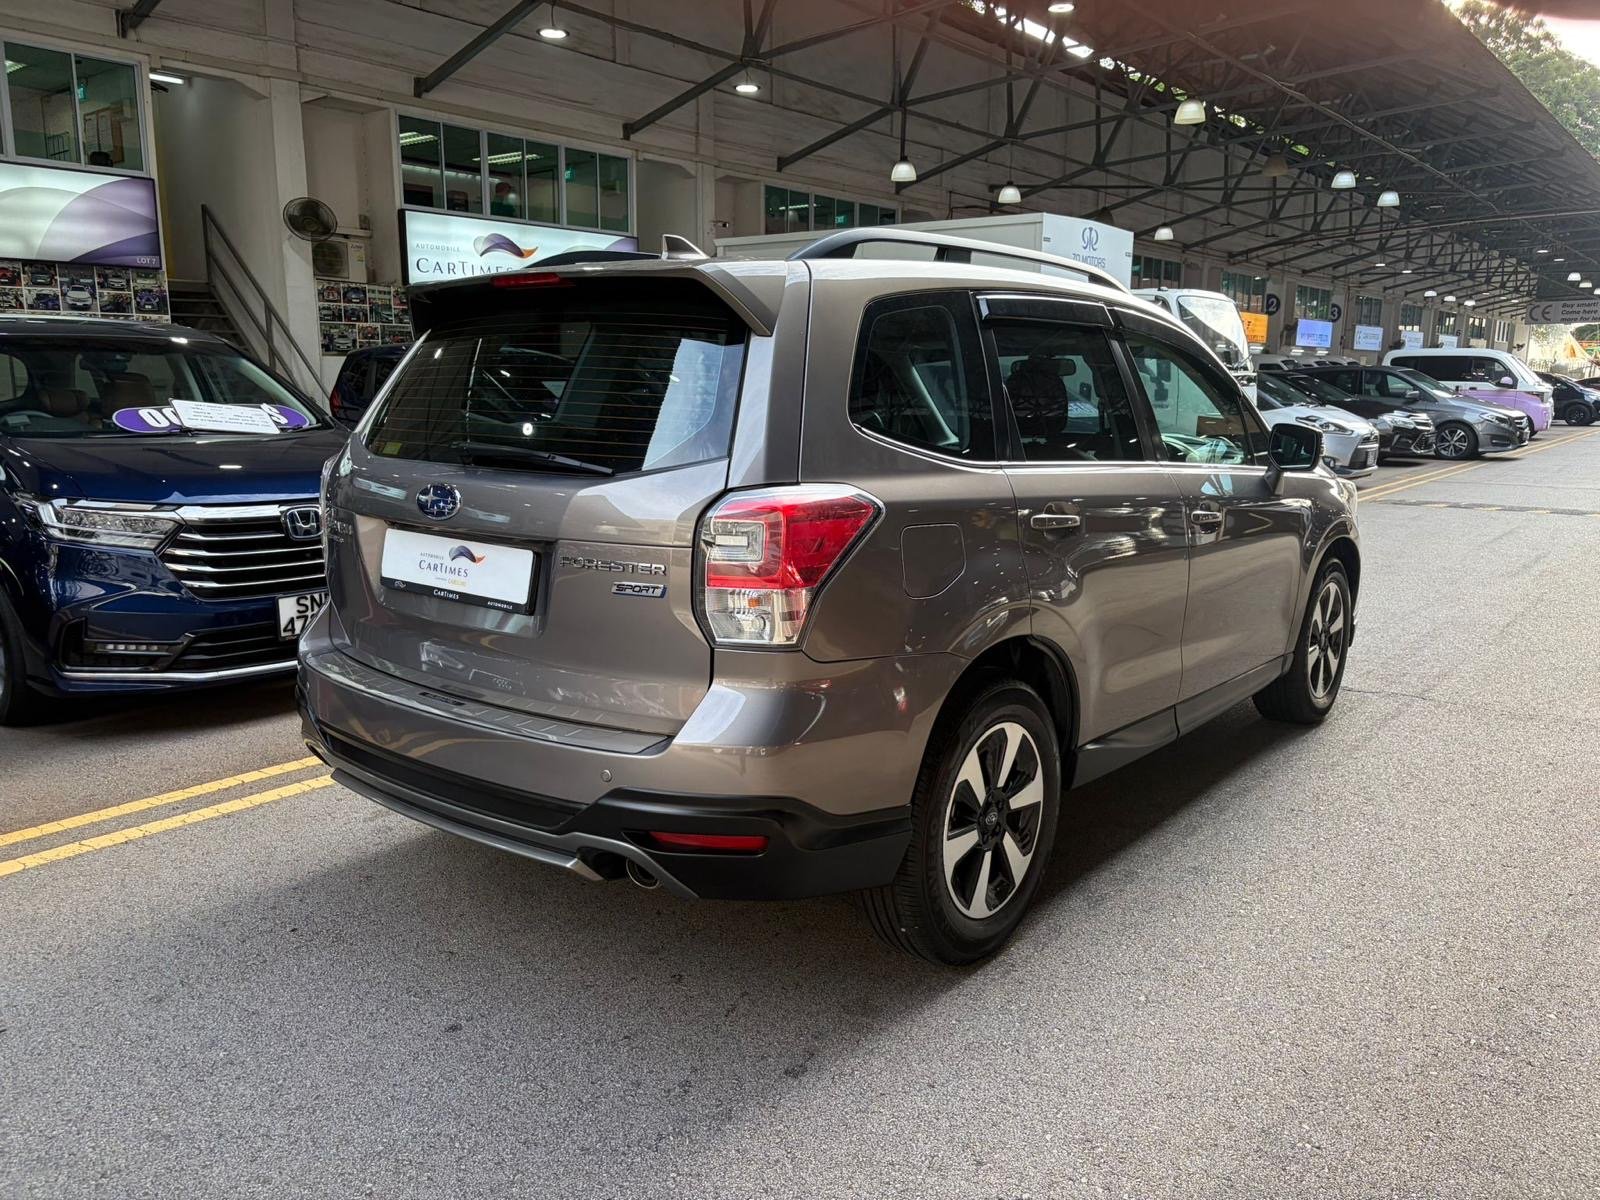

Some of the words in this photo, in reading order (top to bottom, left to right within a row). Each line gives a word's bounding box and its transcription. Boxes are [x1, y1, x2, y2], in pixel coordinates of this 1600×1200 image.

[415, 243, 461, 252] AUTOMOBILE
[136, 257, 150, 265] LOT
[1268, 297, 1277, 312] 2
[560, 556, 667, 577] FORESTER
[615, 583, 661, 595] SPORT
[487, 600, 513, 610] AUTOMOBILE
[283, 614, 317, 635] 47
